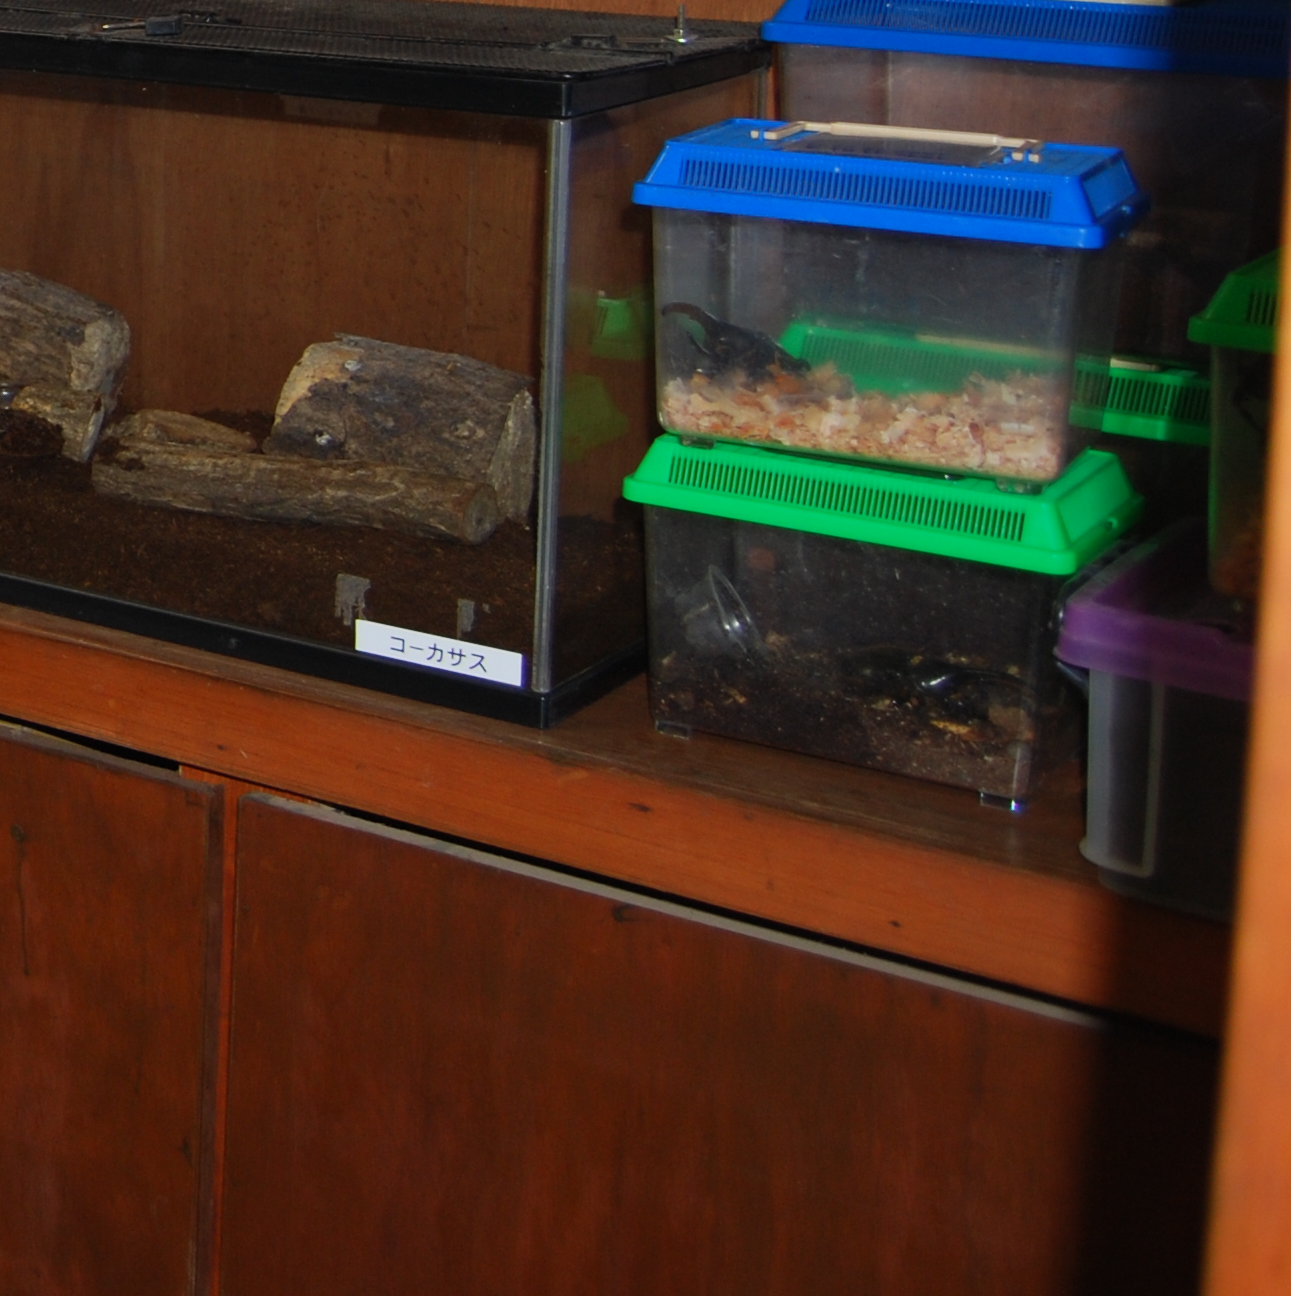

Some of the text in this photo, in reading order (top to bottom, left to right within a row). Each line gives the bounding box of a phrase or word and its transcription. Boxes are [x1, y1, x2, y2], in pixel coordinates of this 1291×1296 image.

[390, 635, 488, 673] コーカサス
